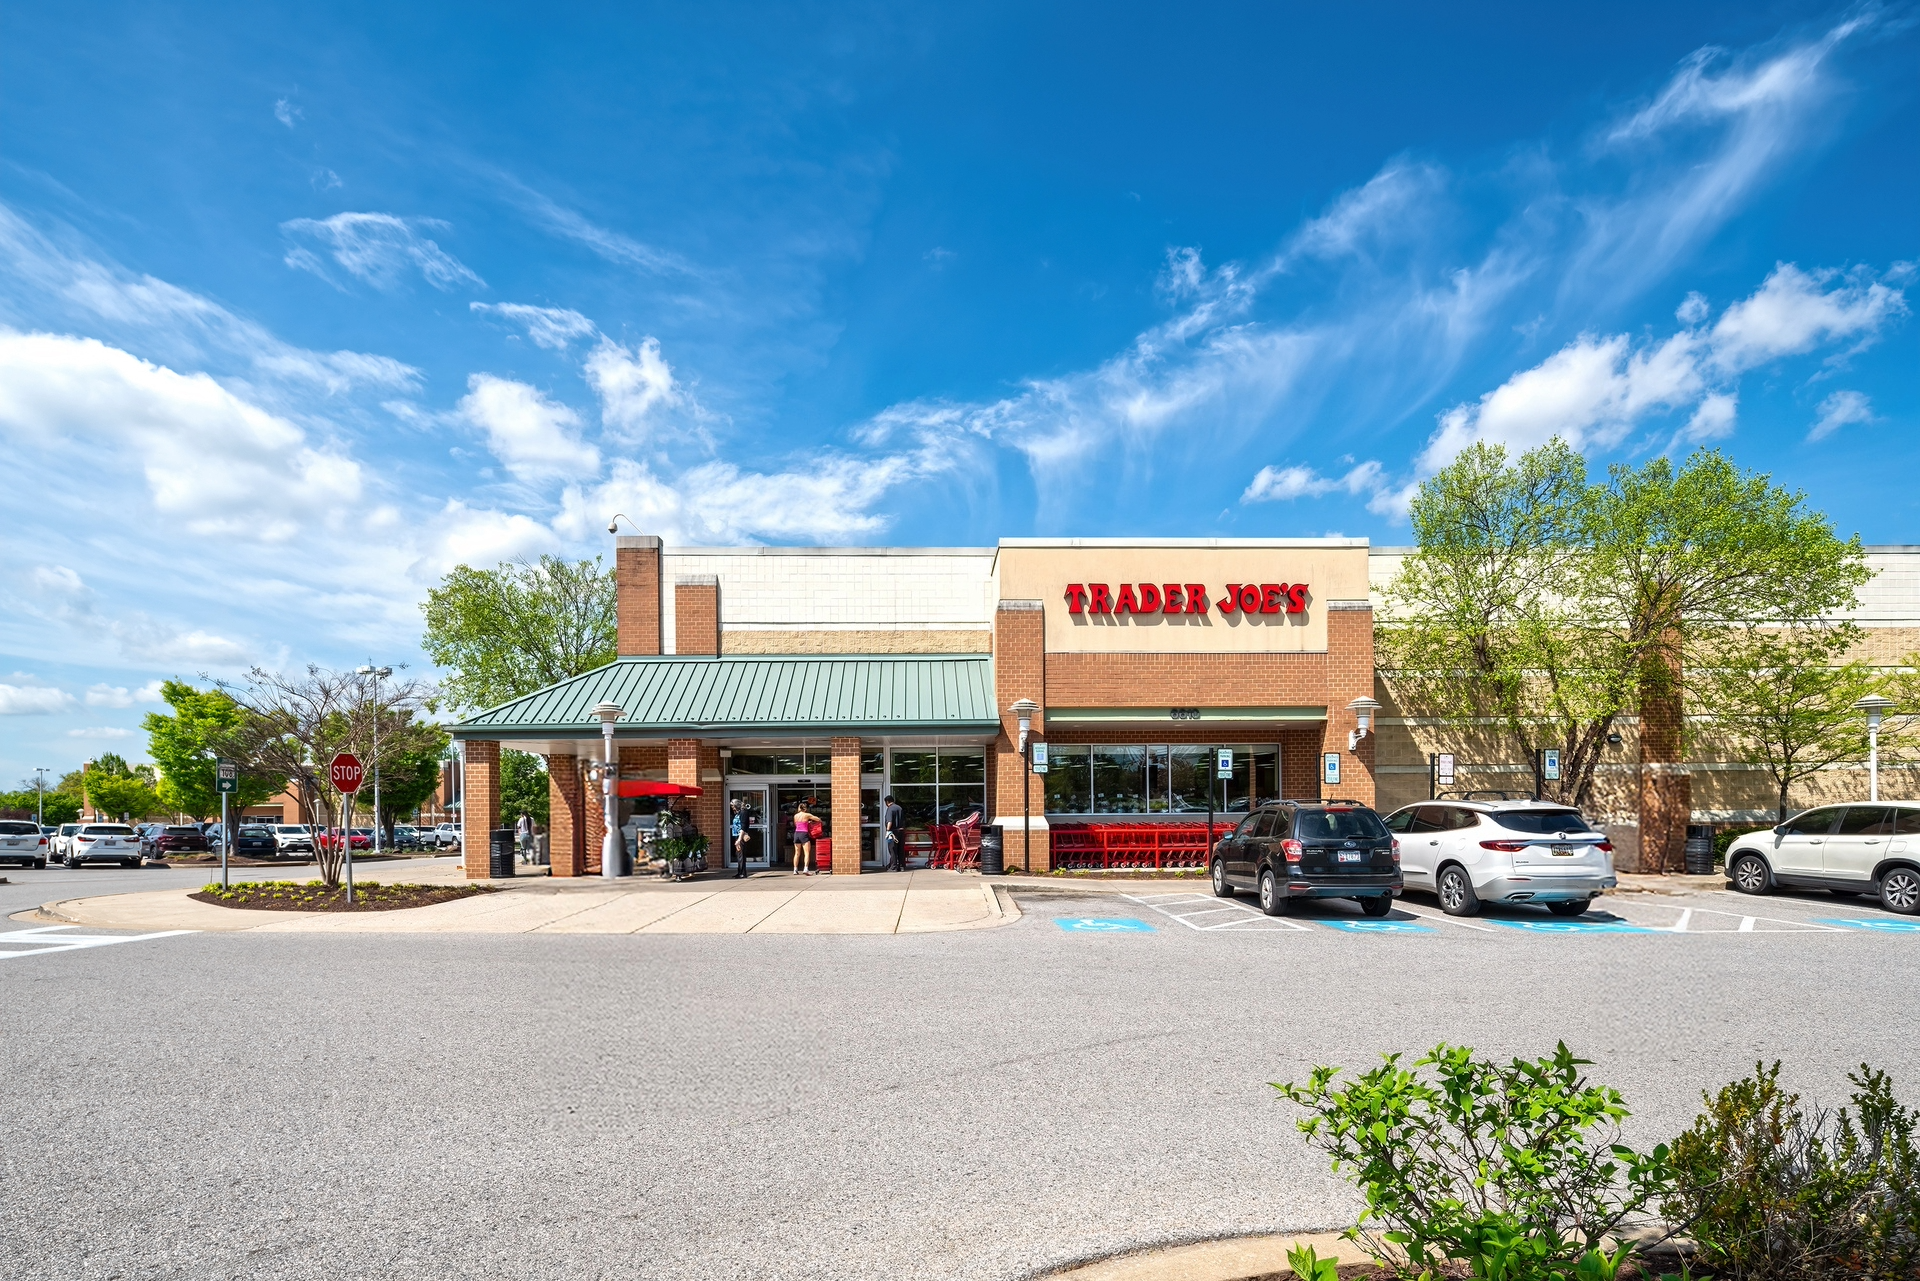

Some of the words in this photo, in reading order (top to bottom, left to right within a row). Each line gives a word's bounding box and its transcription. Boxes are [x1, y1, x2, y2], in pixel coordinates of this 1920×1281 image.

[1065, 583, 1208, 614] TRADER
[1216, 582, 1309, 614] JOE'S
[333, 765, 361, 780] STOP
